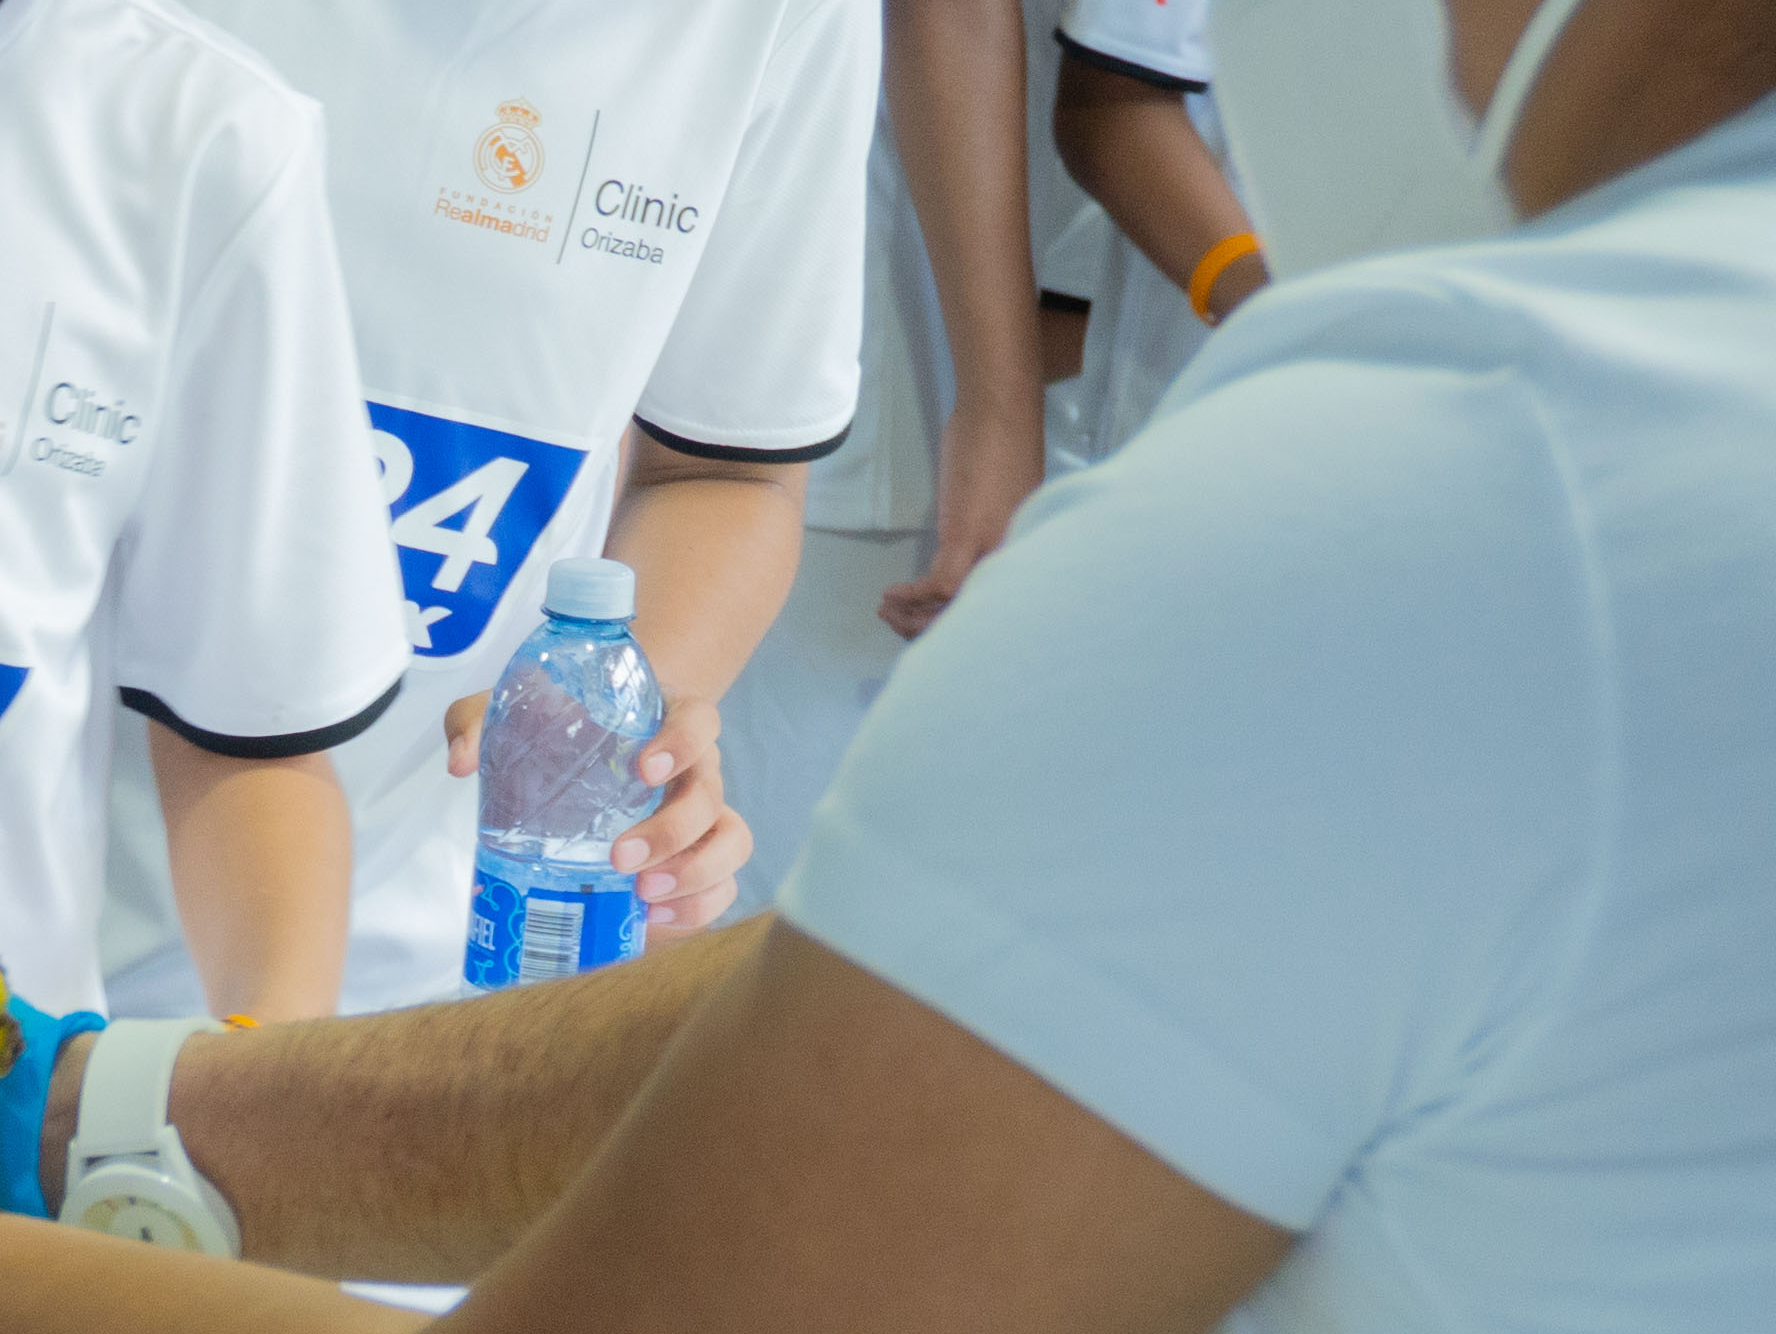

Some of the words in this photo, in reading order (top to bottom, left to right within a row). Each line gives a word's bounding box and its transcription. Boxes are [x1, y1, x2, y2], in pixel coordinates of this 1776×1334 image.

[433, 197, 551, 244] Realmadrid
[594, 179, 700, 234] Clinic
[580, 227, 665, 265] Orizaba
[45, 382, 142, 445] Clinic
